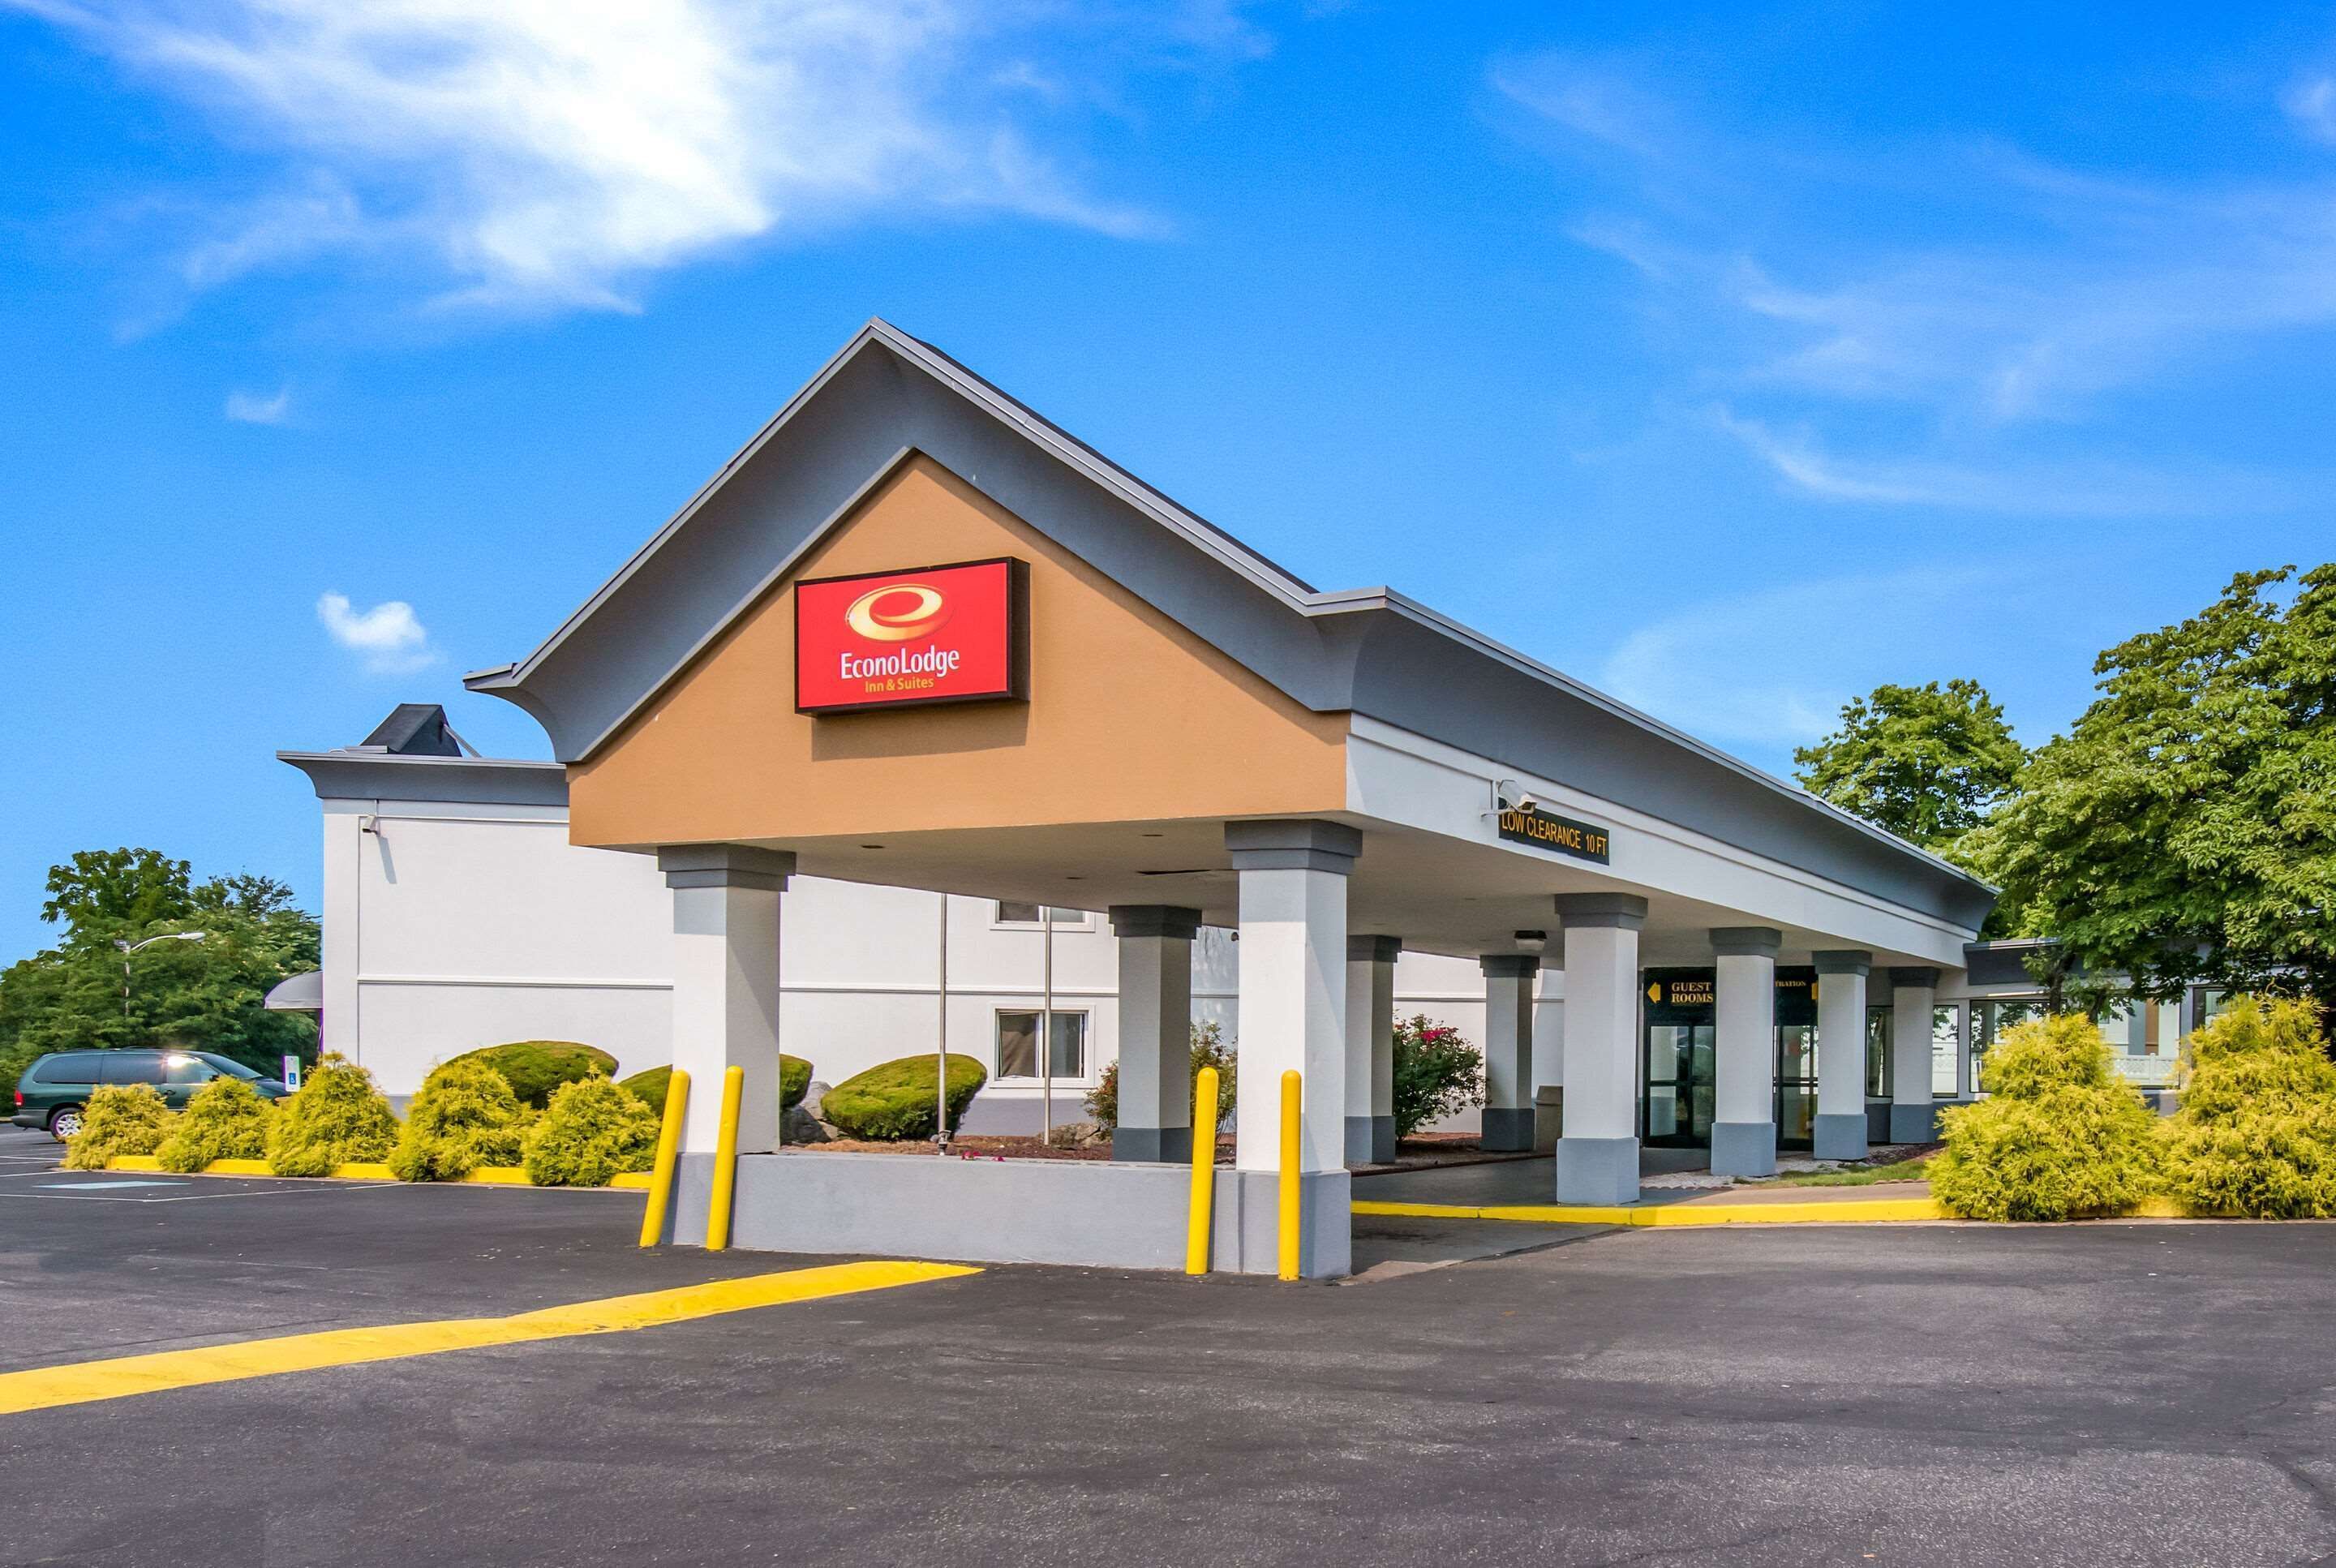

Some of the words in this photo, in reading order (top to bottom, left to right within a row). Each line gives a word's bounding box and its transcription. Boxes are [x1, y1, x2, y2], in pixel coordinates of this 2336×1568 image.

[865, 681, 884, 693] Inn
[886, 679, 895, 691] &
[897, 677, 934, 690] Suites
[1501, 812, 1525, 833] LOW
[1527, 817, 1581, 848] CLEARANCE
[1586, 833, 1595, 853] 10
[1596, 837, 1607, 856] FT
[1671, 982, 1711, 991] GUEST
[1671, 993, 1714, 1003] ROOMS
